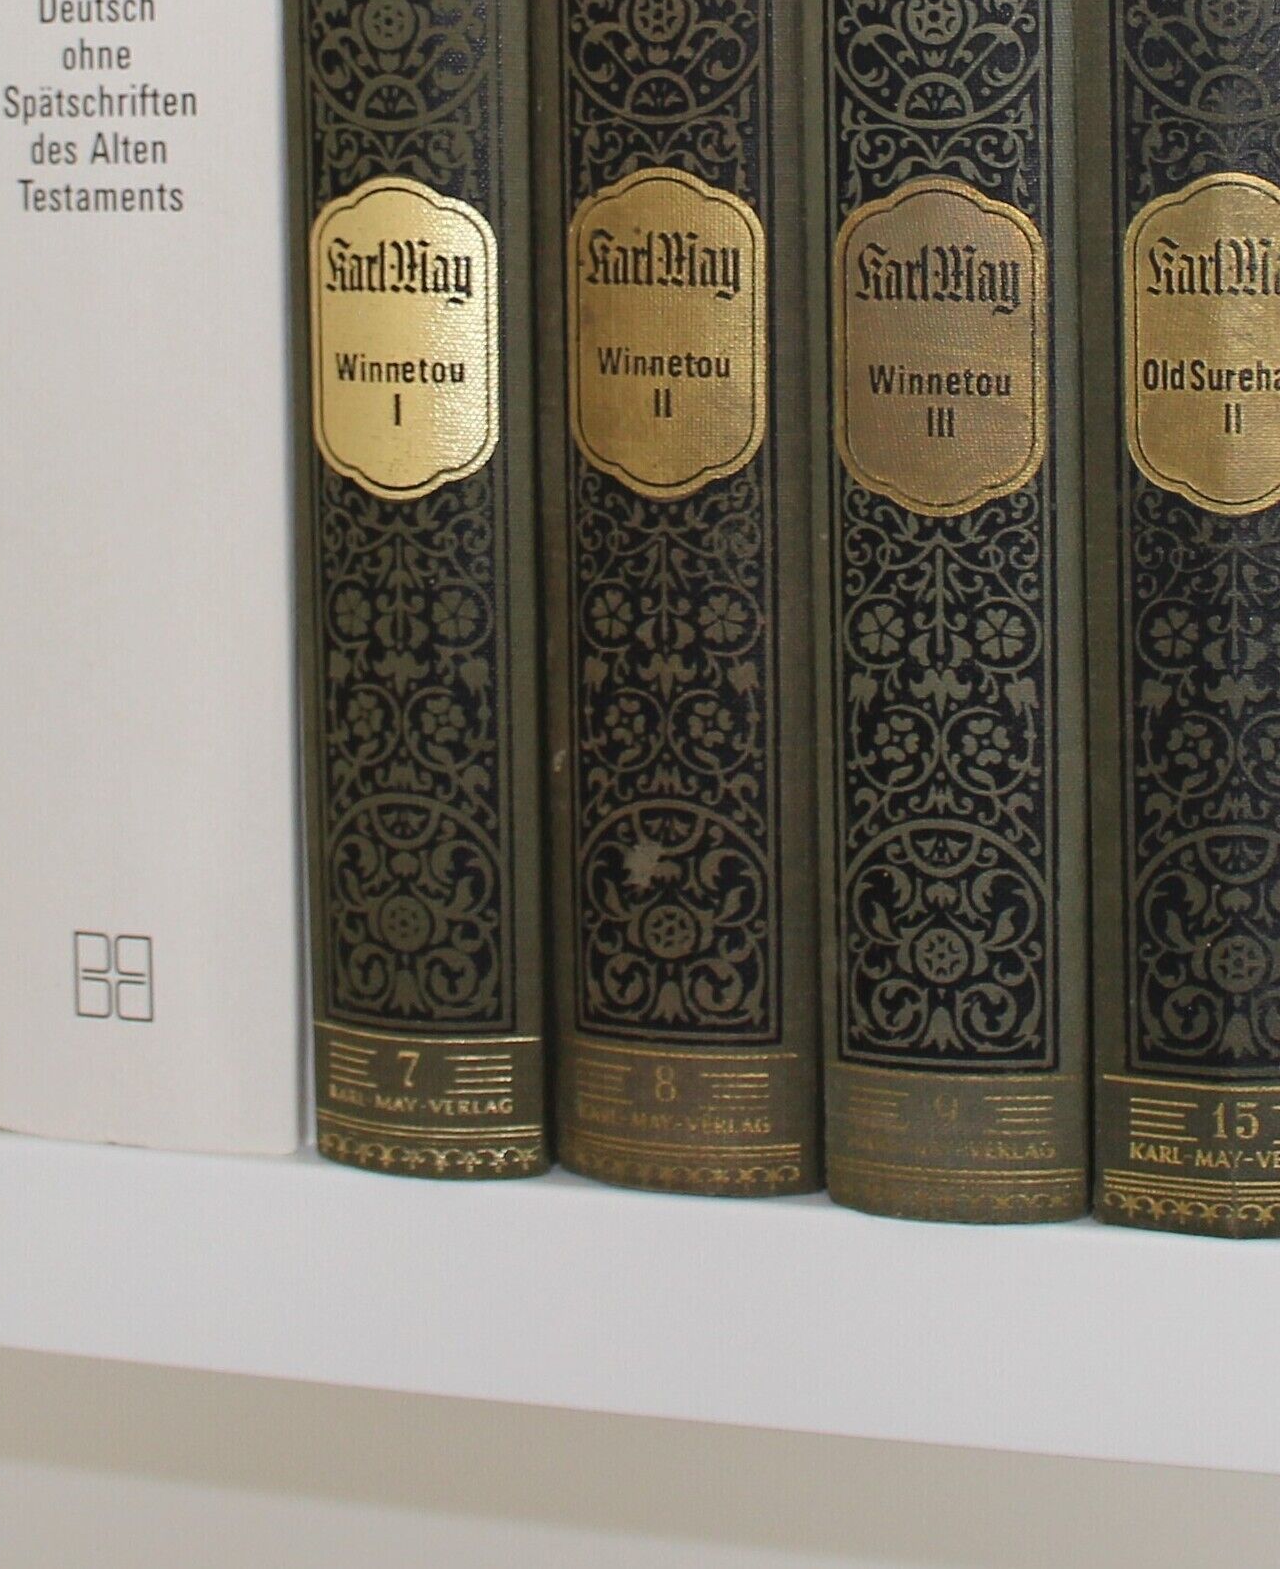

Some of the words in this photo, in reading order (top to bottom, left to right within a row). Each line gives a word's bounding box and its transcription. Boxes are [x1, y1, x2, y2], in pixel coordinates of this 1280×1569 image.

[62, 37, 131, 71] ohne
[2, 82, 198, 124] Spätschriften
[30, 131, 78, 165] des
[89, 130, 168, 165] Alten
[16, 178, 185, 213] Testaments
[326, 236, 387, 293] Karl
[389, 239, 474, 305] May
[584, 228, 654, 286] Karl
[655, 231, 743, 302] May
[855, 241, 931, 303] Karl
[932, 243, 1022, 316] May
[1144, 235, 1223, 298] Karl
[334, 352, 467, 384] Winnetou
[597, 346, 732, 379] Winnetou
[1142, 357, 1186, 392] Old
[867, 363, 1013, 398] Winnetou
[393, 393, 402, 427] I
[652, 387, 673, 419] II
[1224, 402, 1243, 436] II
[926, 405, 956, 439] III
[396, 1049, 420, 1088] 7
[655, 1064, 677, 1103] 8
[1212, 1101, 1260, 1140] 15
